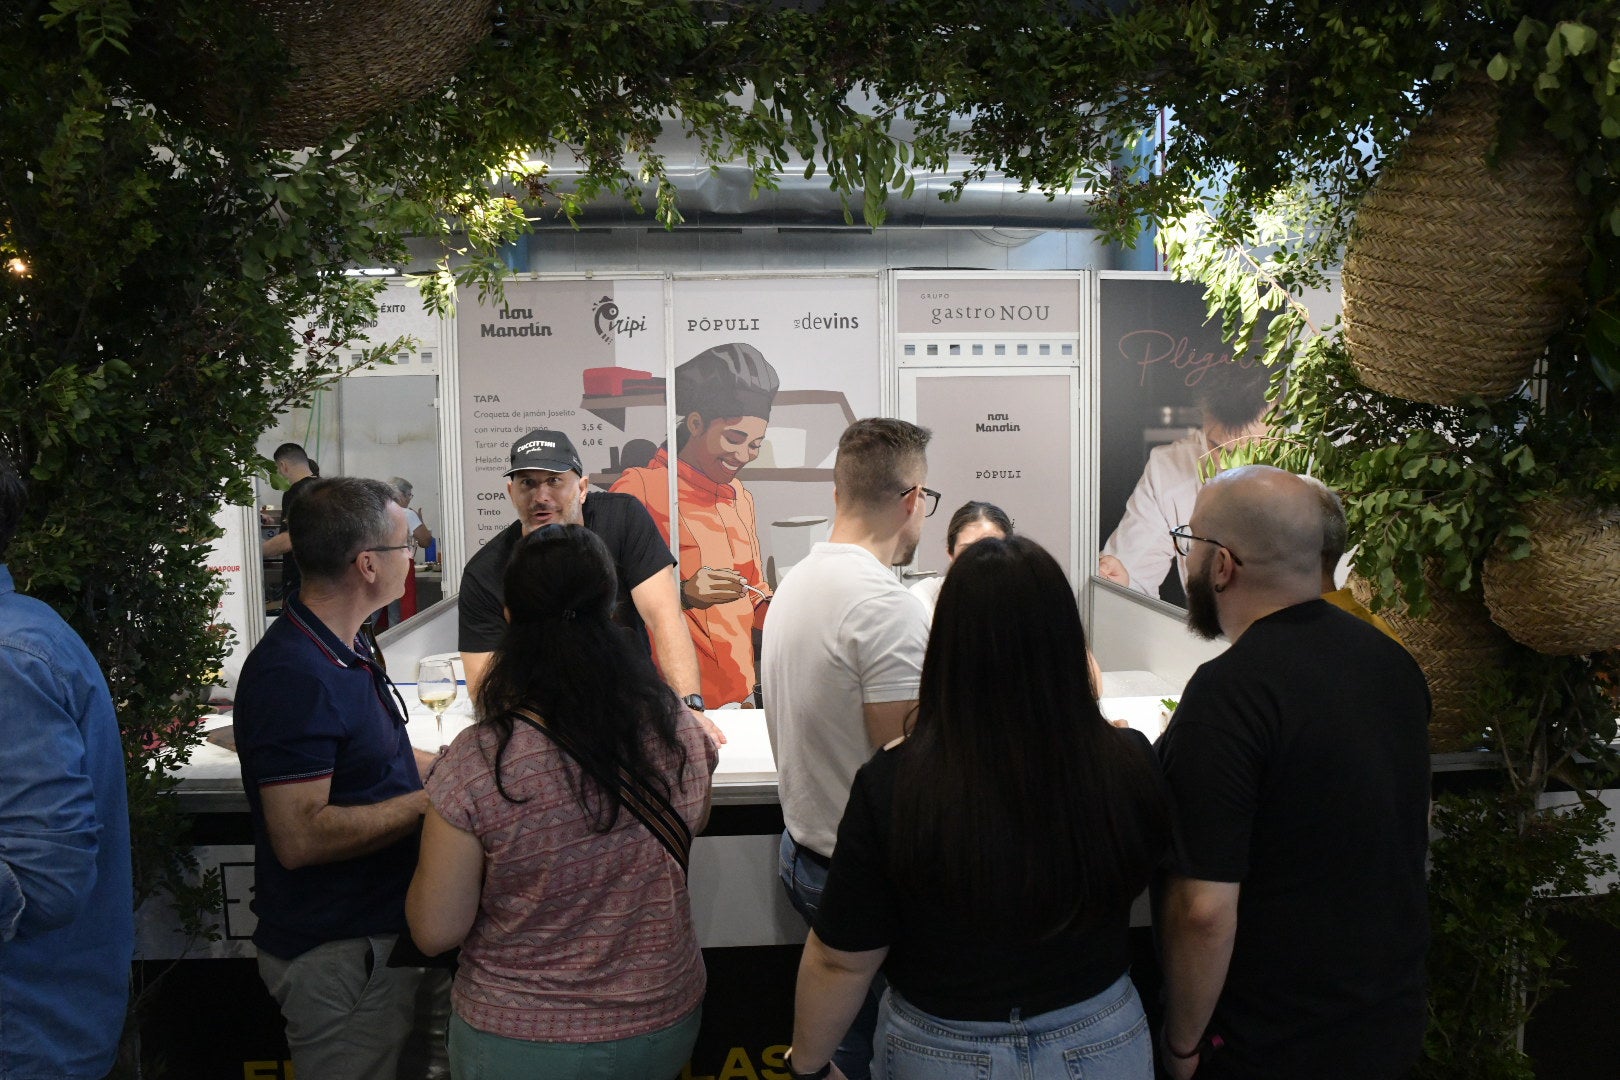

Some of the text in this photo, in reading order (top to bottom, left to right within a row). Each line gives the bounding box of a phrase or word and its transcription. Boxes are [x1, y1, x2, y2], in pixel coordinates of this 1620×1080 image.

[380, 303, 405, 313] ÉXITO
[499, 308, 534, 320] nou
[473, 395, 501, 403] TAPA
[473, 409, 576, 419] Croqueta de jamón Joselito
[987, 413, 1010, 421] nou
[490, 425, 512, 433] viruta
[581, 423, 603, 432] 3,5 €
[474, 441, 498, 449] Tartar
[500, 440, 510, 448] de
[582, 438, 603, 447] 6,0 €
[475, 456, 503, 464] Helado
[476, 493, 506, 501] COPA
[477, 508, 501, 516] Tinto
[477, 523, 493, 531] Una
